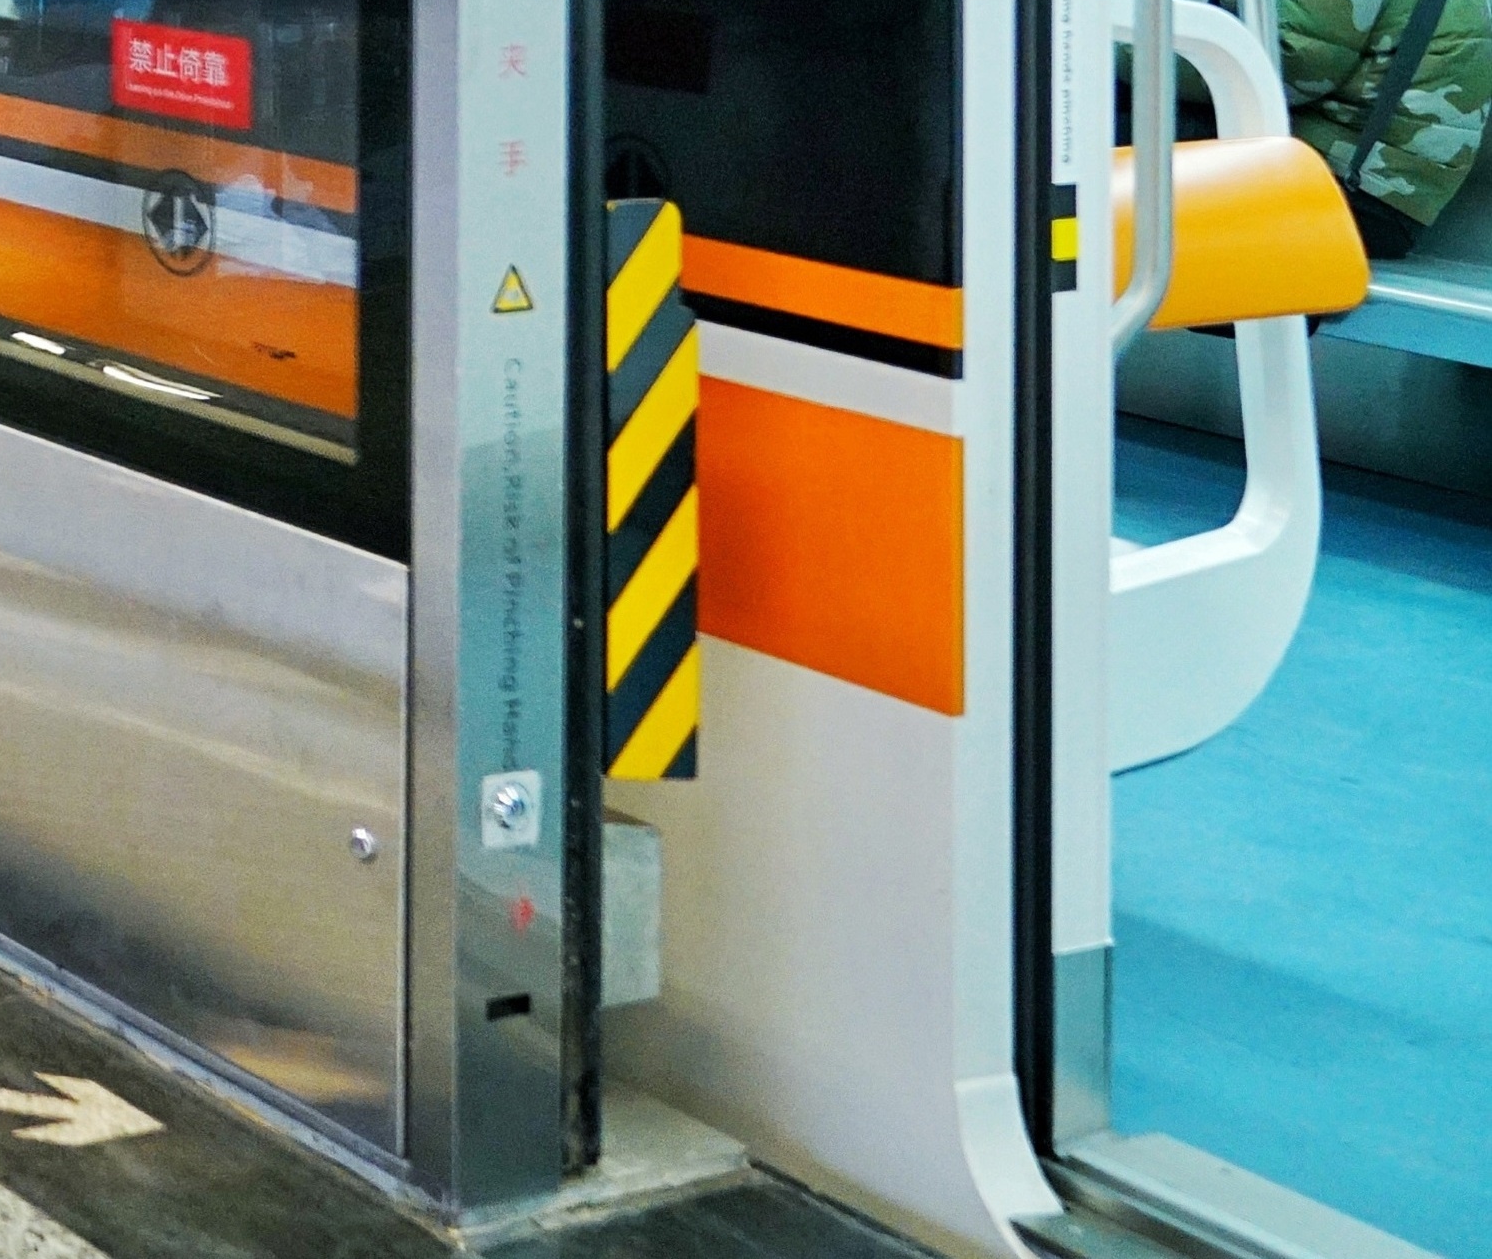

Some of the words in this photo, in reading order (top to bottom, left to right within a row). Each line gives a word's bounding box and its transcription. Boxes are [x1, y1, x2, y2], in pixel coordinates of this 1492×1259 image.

[128, 38, 230, 88] 禁止倚靠
[497, 571, 524, 693] Pinching
